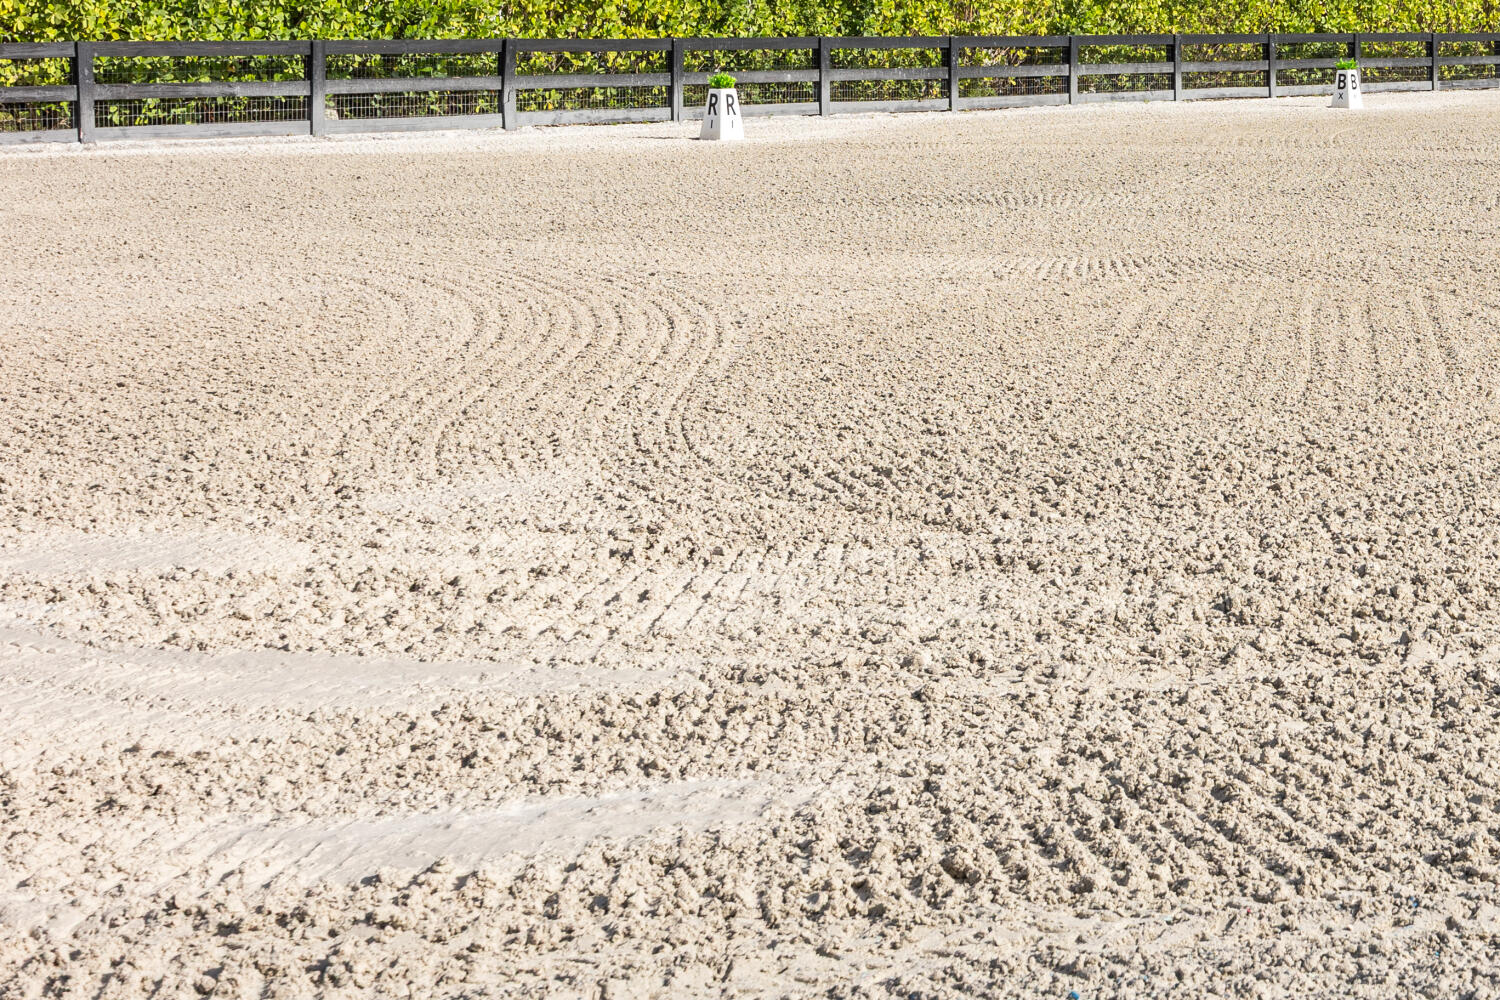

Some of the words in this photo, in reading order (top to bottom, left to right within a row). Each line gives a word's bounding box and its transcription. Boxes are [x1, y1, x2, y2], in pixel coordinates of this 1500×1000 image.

[1337, 73, 1347, 90] B
[1350, 73, 1358, 90] B
[707, 93, 718, 116] R
[725, 93, 737, 116] R
